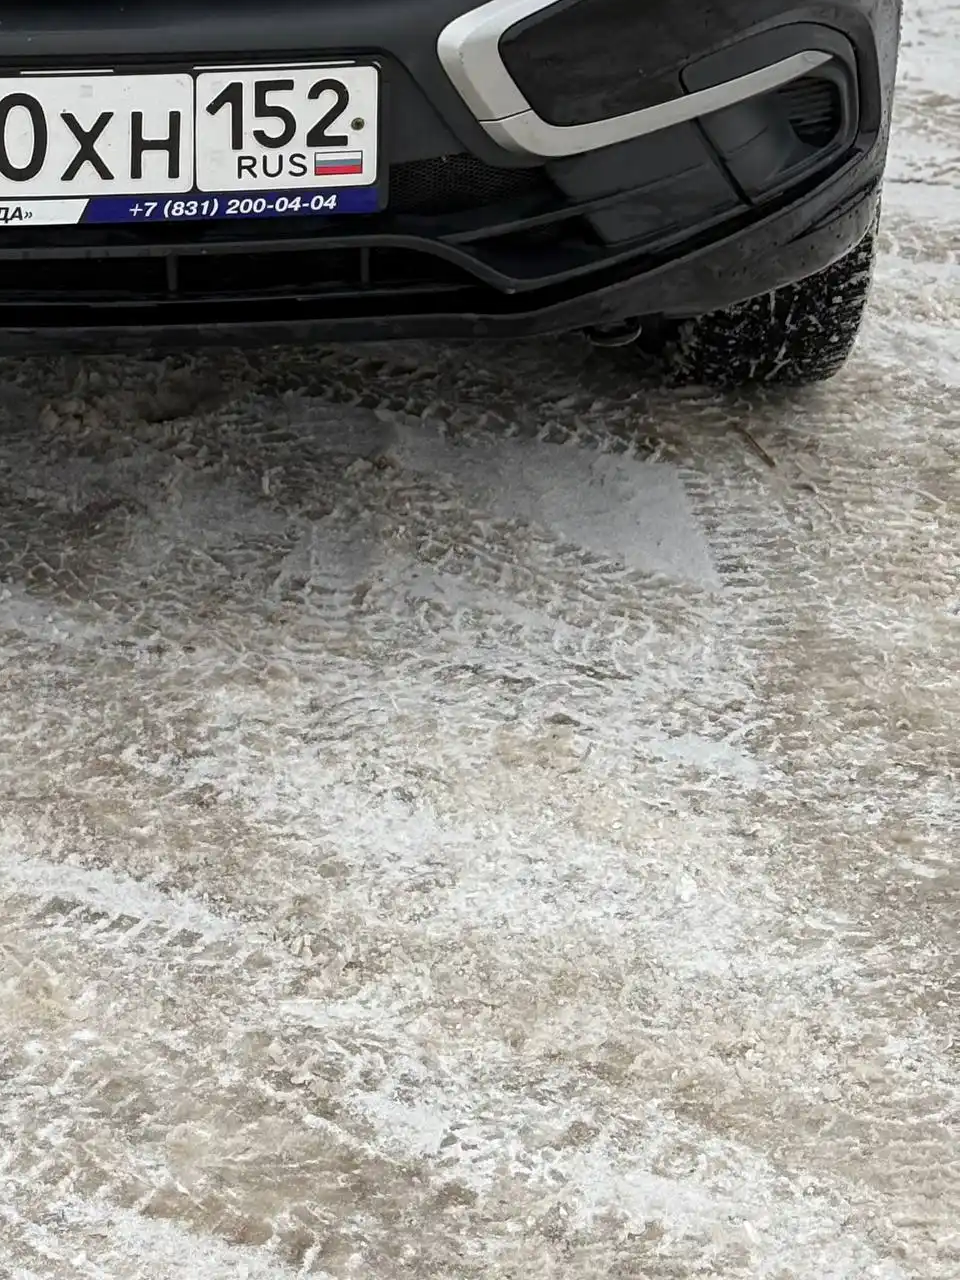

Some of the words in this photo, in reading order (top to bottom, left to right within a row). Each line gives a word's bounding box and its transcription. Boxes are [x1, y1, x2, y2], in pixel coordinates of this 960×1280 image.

[206, 78, 350, 150] 152
[237, 153, 308, 179] RUS
[129, 202, 157, 218] +7
[163, 198, 219, 218] (831)
[225, 194, 337, 215] 200-04-04
